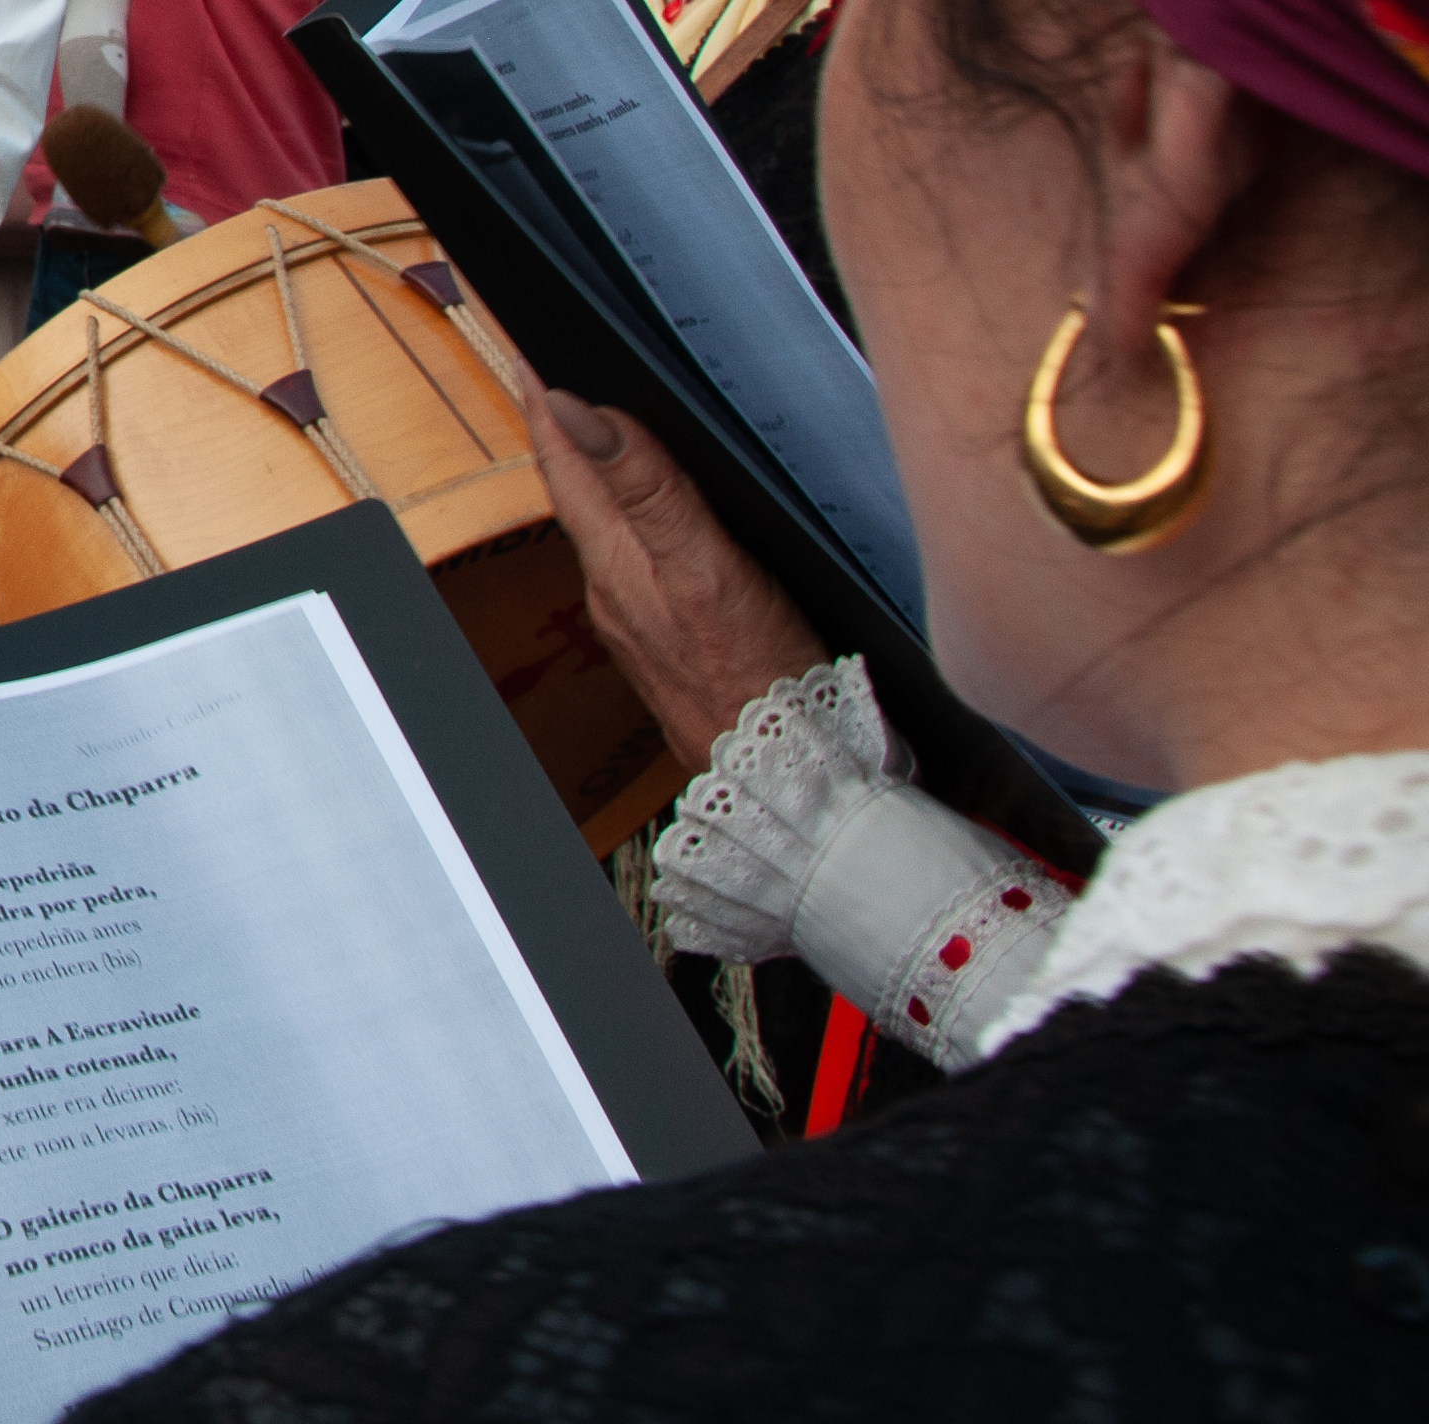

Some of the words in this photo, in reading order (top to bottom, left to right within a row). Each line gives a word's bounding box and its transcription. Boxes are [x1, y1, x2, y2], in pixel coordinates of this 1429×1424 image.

[27, 798, 62, 820] da
[65, 763, 200, 813] Chaparra
[38, 898, 78, 921] por
[82, 884, 158, 914] pedra,
[92, 917, 144, 942] antes
[21, 958, 100, 986] enchera
[101, 947, 143, 976] (bis)
[45, 1025, 63, 1047] A
[63, 1002, 202, 1043] Escravitude
[64, 1042, 178, 1078] cotenada,
[1, 1102, 57, 1129] xente
[63, 1095, 97, 1117] era
[101, 1077, 183, 1108] dicirme:
[33, 1134, 76, 1158] non
[81, 1132, 93, 1149] a
[175, 1102, 220, 1133] (bis)
[20, 1199, 119, 1241] gaiteiro
[123, 1189, 155, 1212] da
[157, 1166, 275, 1204] Chaparra
[4, 1256, 40, 1278] no
[44, 1240, 117, 1269] ronco
[121, 1227, 154, 1251] da
[158, 1216, 219, 1250] gaita
[219, 1204, 282, 1230] leva,
[19, 1292, 53, 1317] un
[54, 1274, 136, 1306] letreiro
[140, 1260, 178, 1293] que
[32, 1314, 135, 1353] Santiago
[138, 1303, 167, 1327] de
